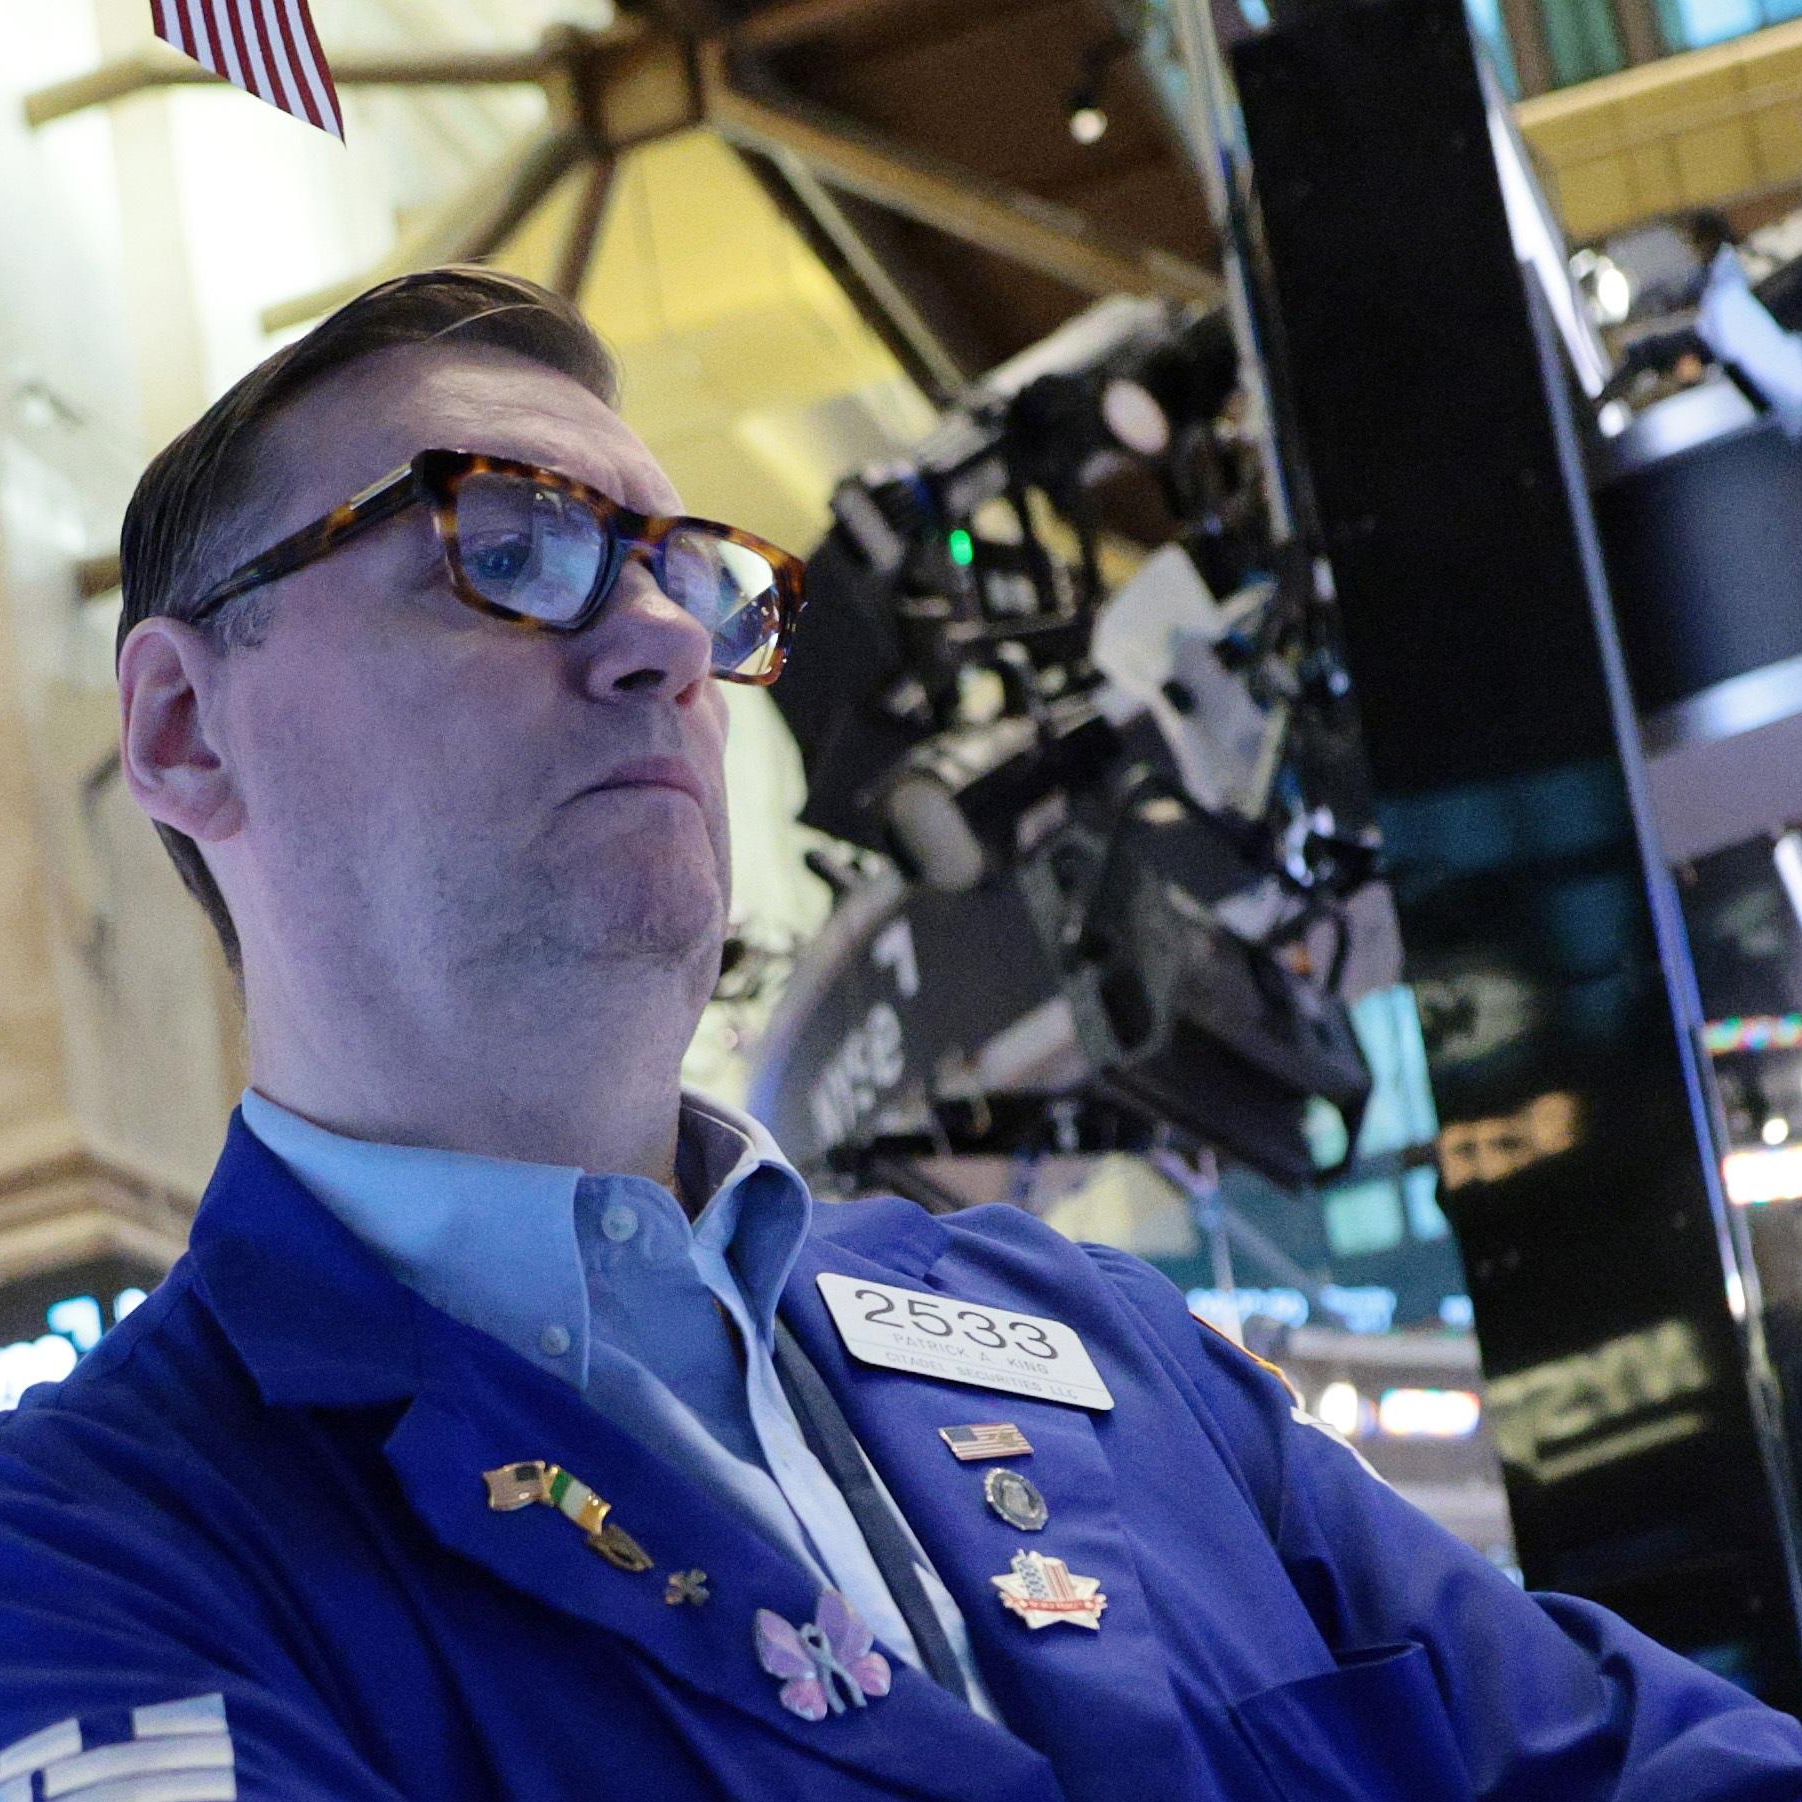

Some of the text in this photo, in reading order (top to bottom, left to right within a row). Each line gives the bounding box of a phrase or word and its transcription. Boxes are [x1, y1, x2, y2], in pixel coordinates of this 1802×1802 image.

[855, 1289, 1058, 1360] 2533
[885, 1352, 1079, 1400] CITADEL SECURITIES LLC
[894, 1333, 1048, 1374] PATRICK A KING
